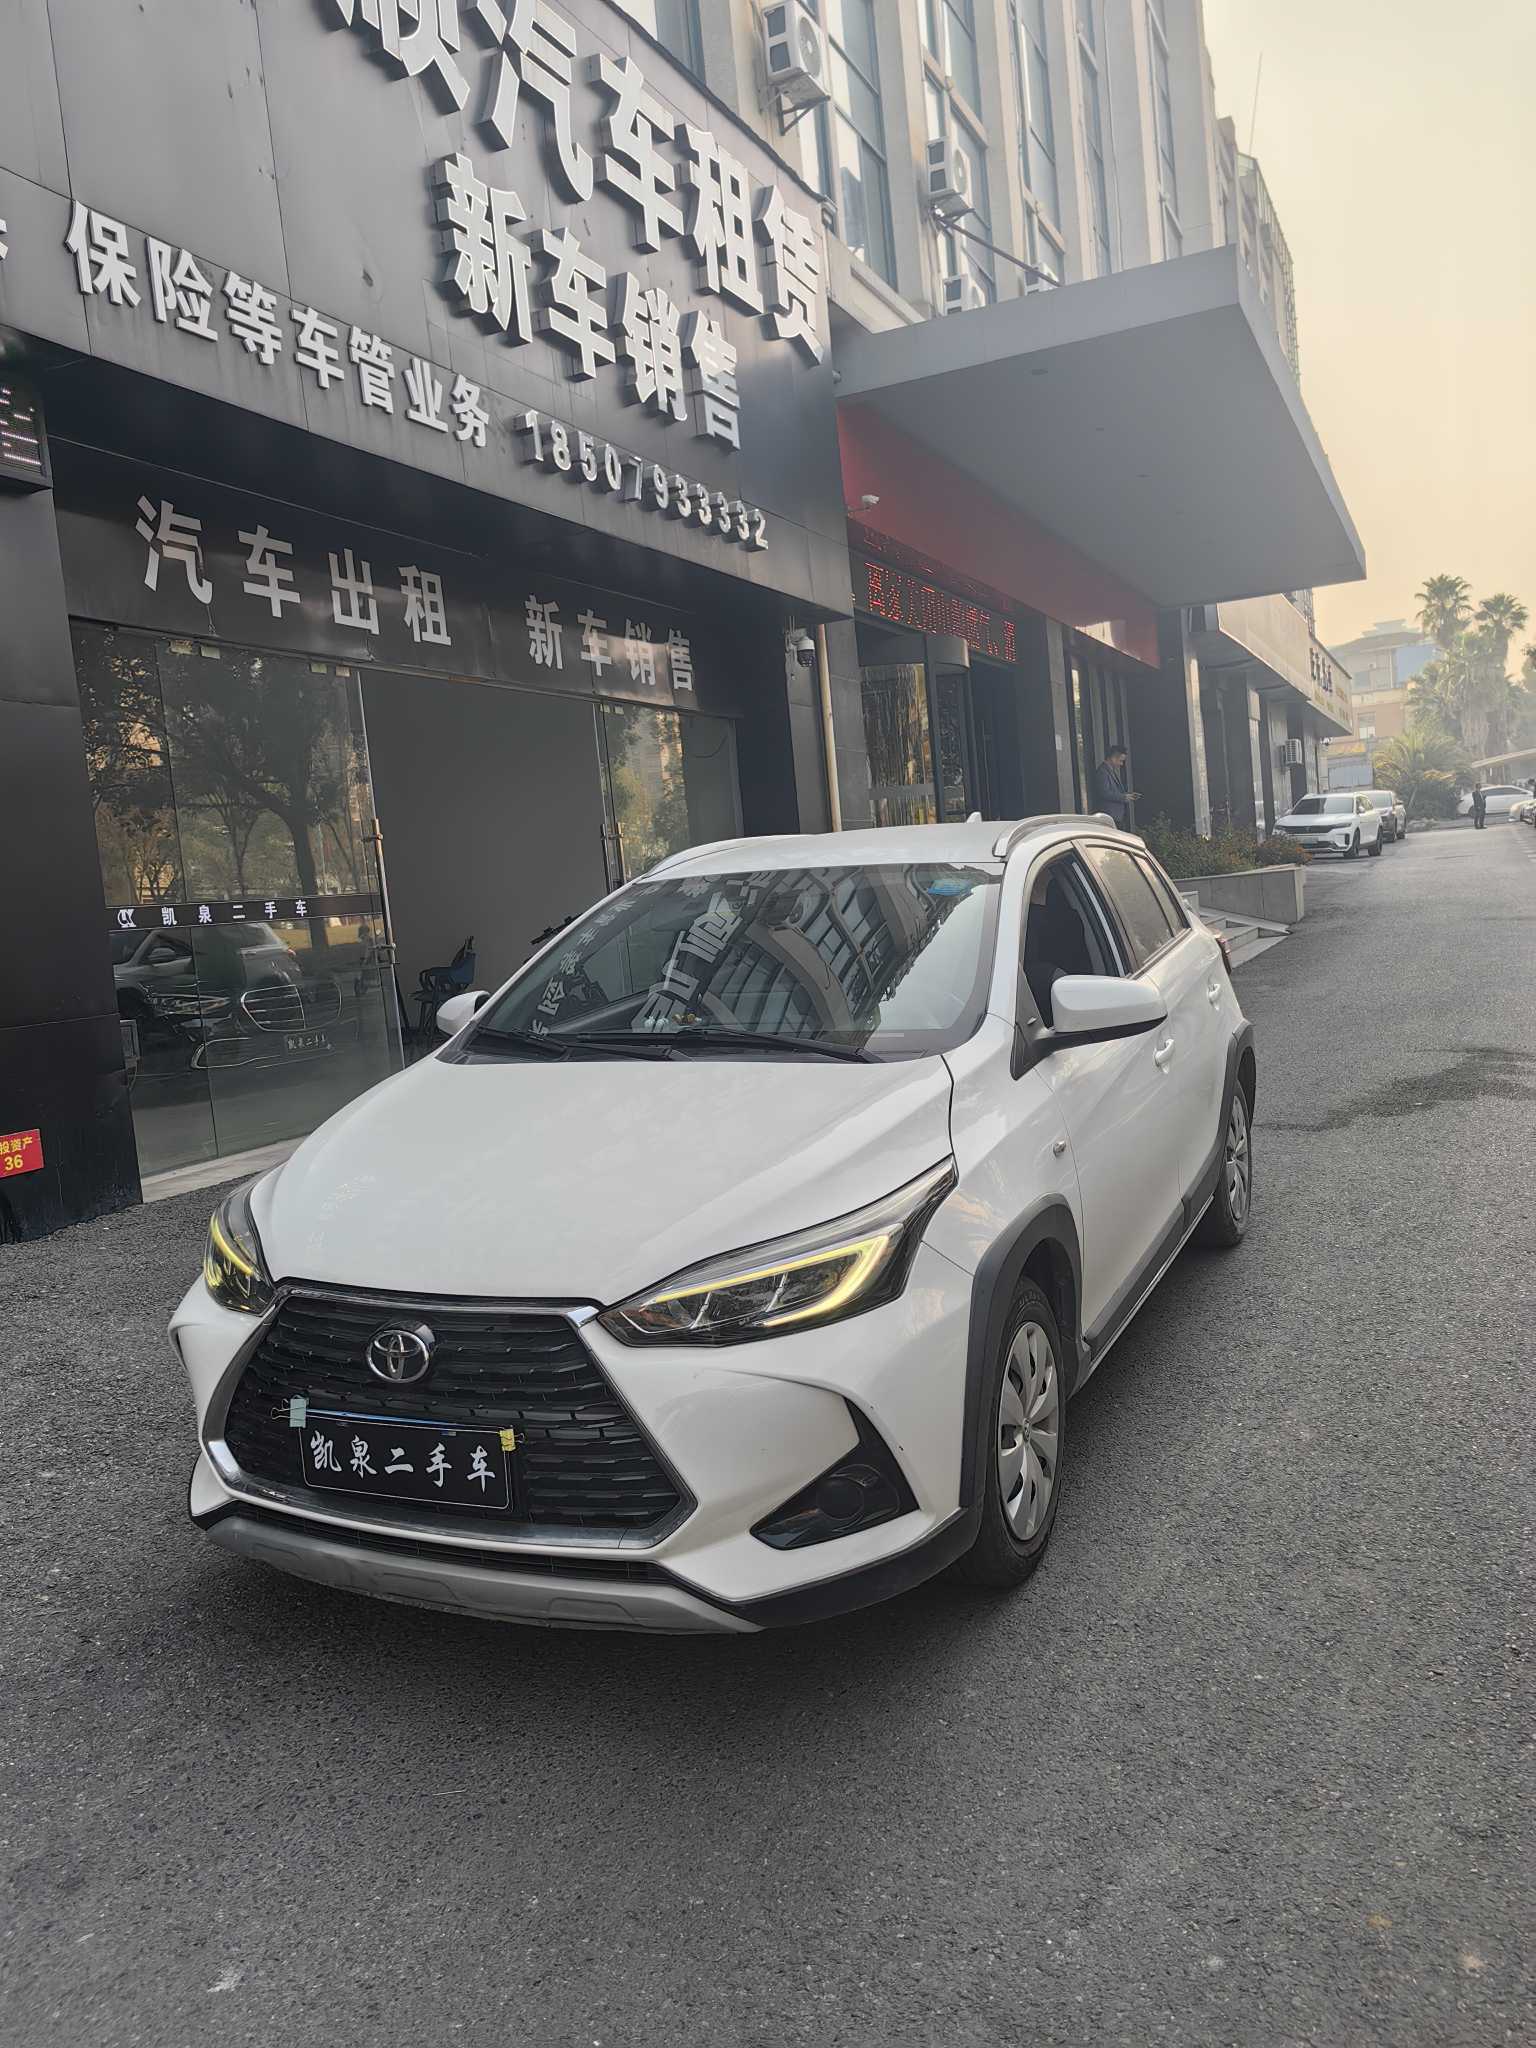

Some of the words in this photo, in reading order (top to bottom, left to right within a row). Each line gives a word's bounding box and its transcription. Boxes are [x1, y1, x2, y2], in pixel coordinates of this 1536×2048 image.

[442, 153, 742, 450] 新车销售
[65, 200, 490, 448] 保险等车管业务
[520, 409, 769, 550] 18507933332
[136, 495, 451, 647] 汽车出租
[525, 594, 693, 692] 新车销售
[161, 899, 308, 926] 凯泉二手车
[4, 1154, 24, 1171] 36
[310, 1430, 496, 1493] 凯泉二手车
